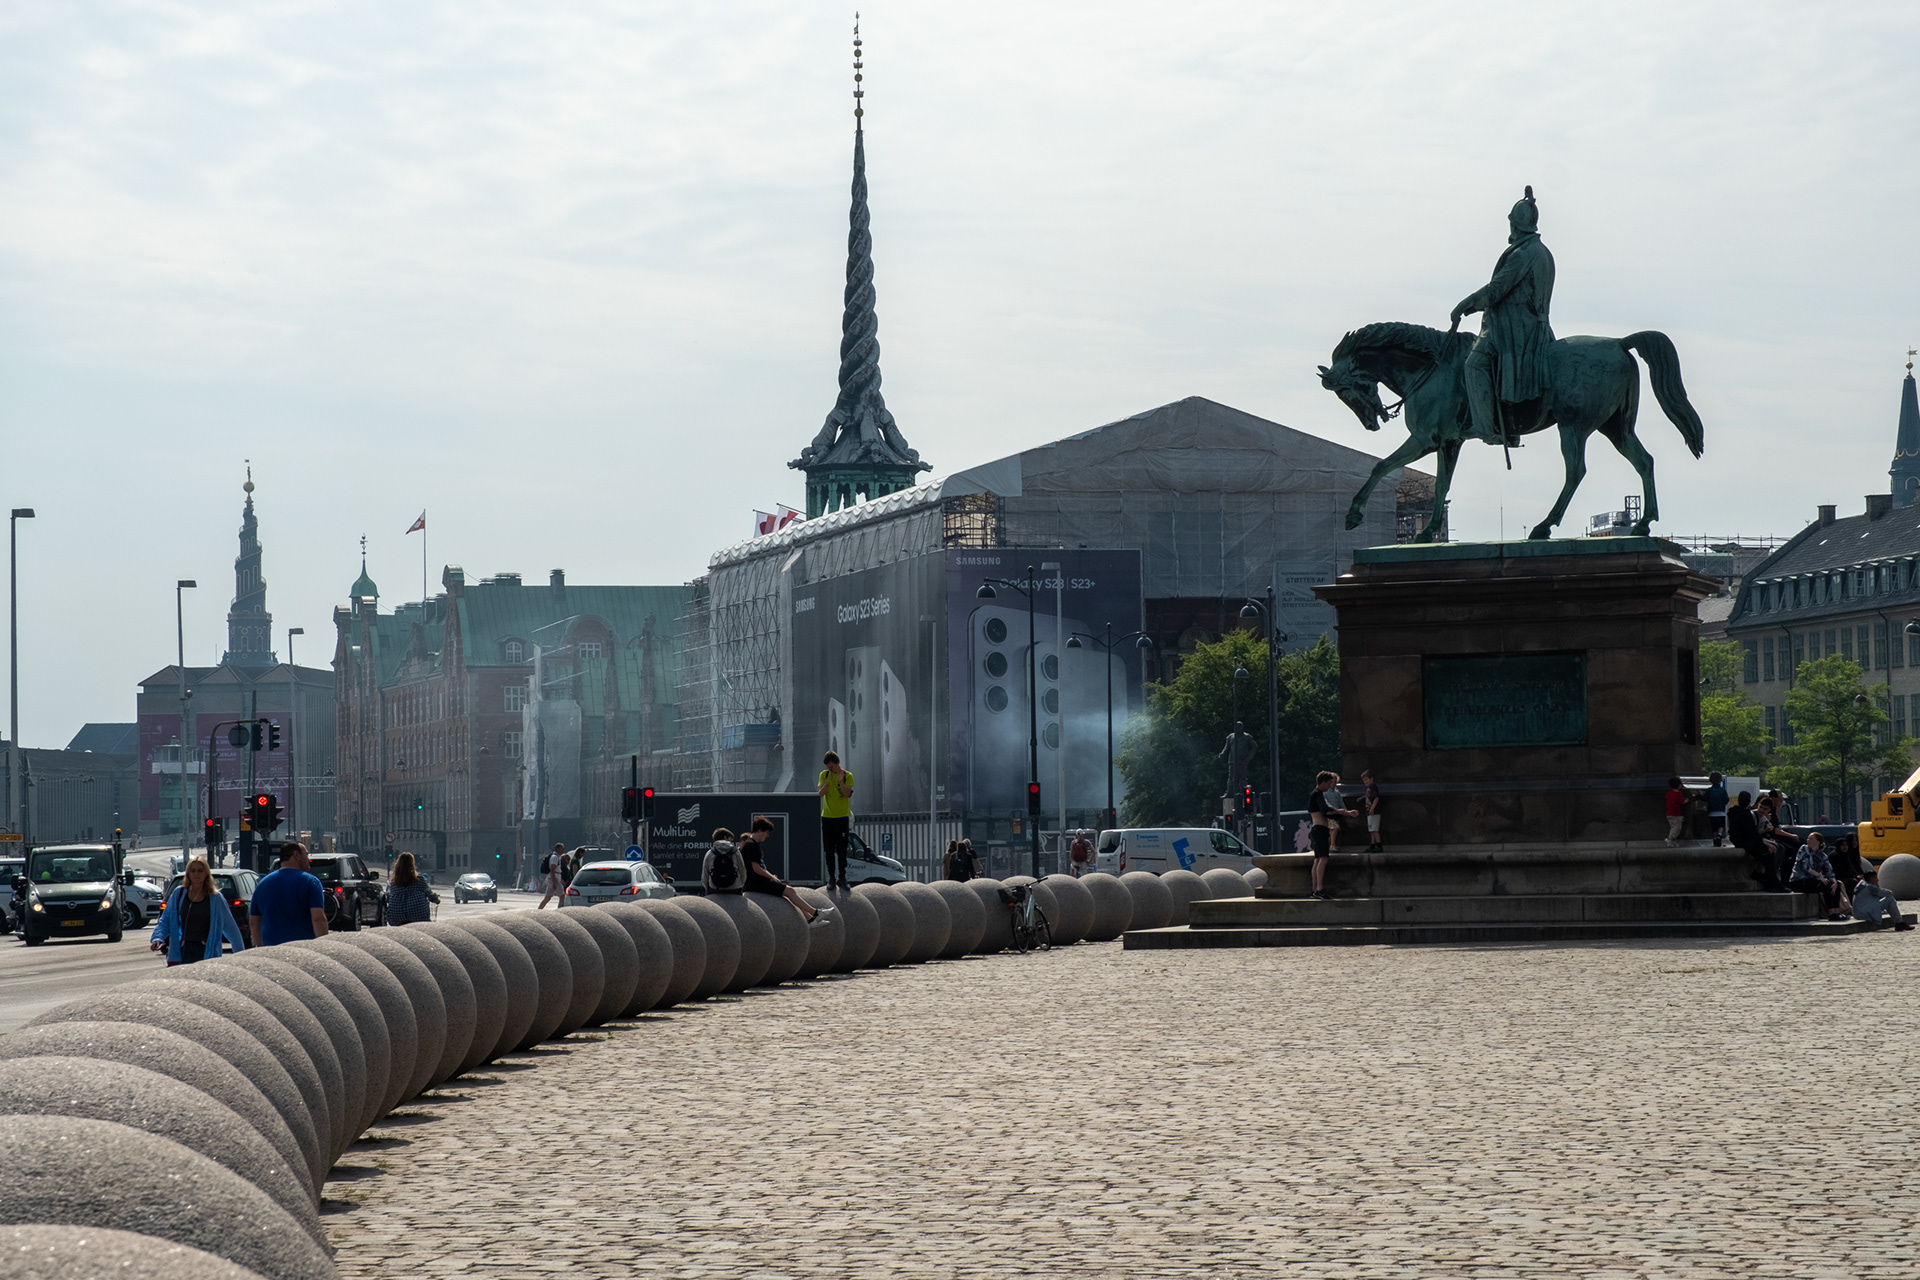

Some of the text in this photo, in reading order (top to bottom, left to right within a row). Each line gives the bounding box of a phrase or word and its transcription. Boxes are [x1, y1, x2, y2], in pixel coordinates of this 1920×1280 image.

[955, 556, 1001, 565] SAMSUNG
[999, 577, 1043, 591] Galaxy
[1071, 578, 1096, 589] S23+
[795, 597, 815, 613] SAMSUNG
[837, 594, 890, 625] Galaxy S23 Series
[652, 825, 697, 837] MultiLine
[884, 834, 891, 843] P
[652, 842, 666, 850] Alle
[667, 841, 682, 850] dine
